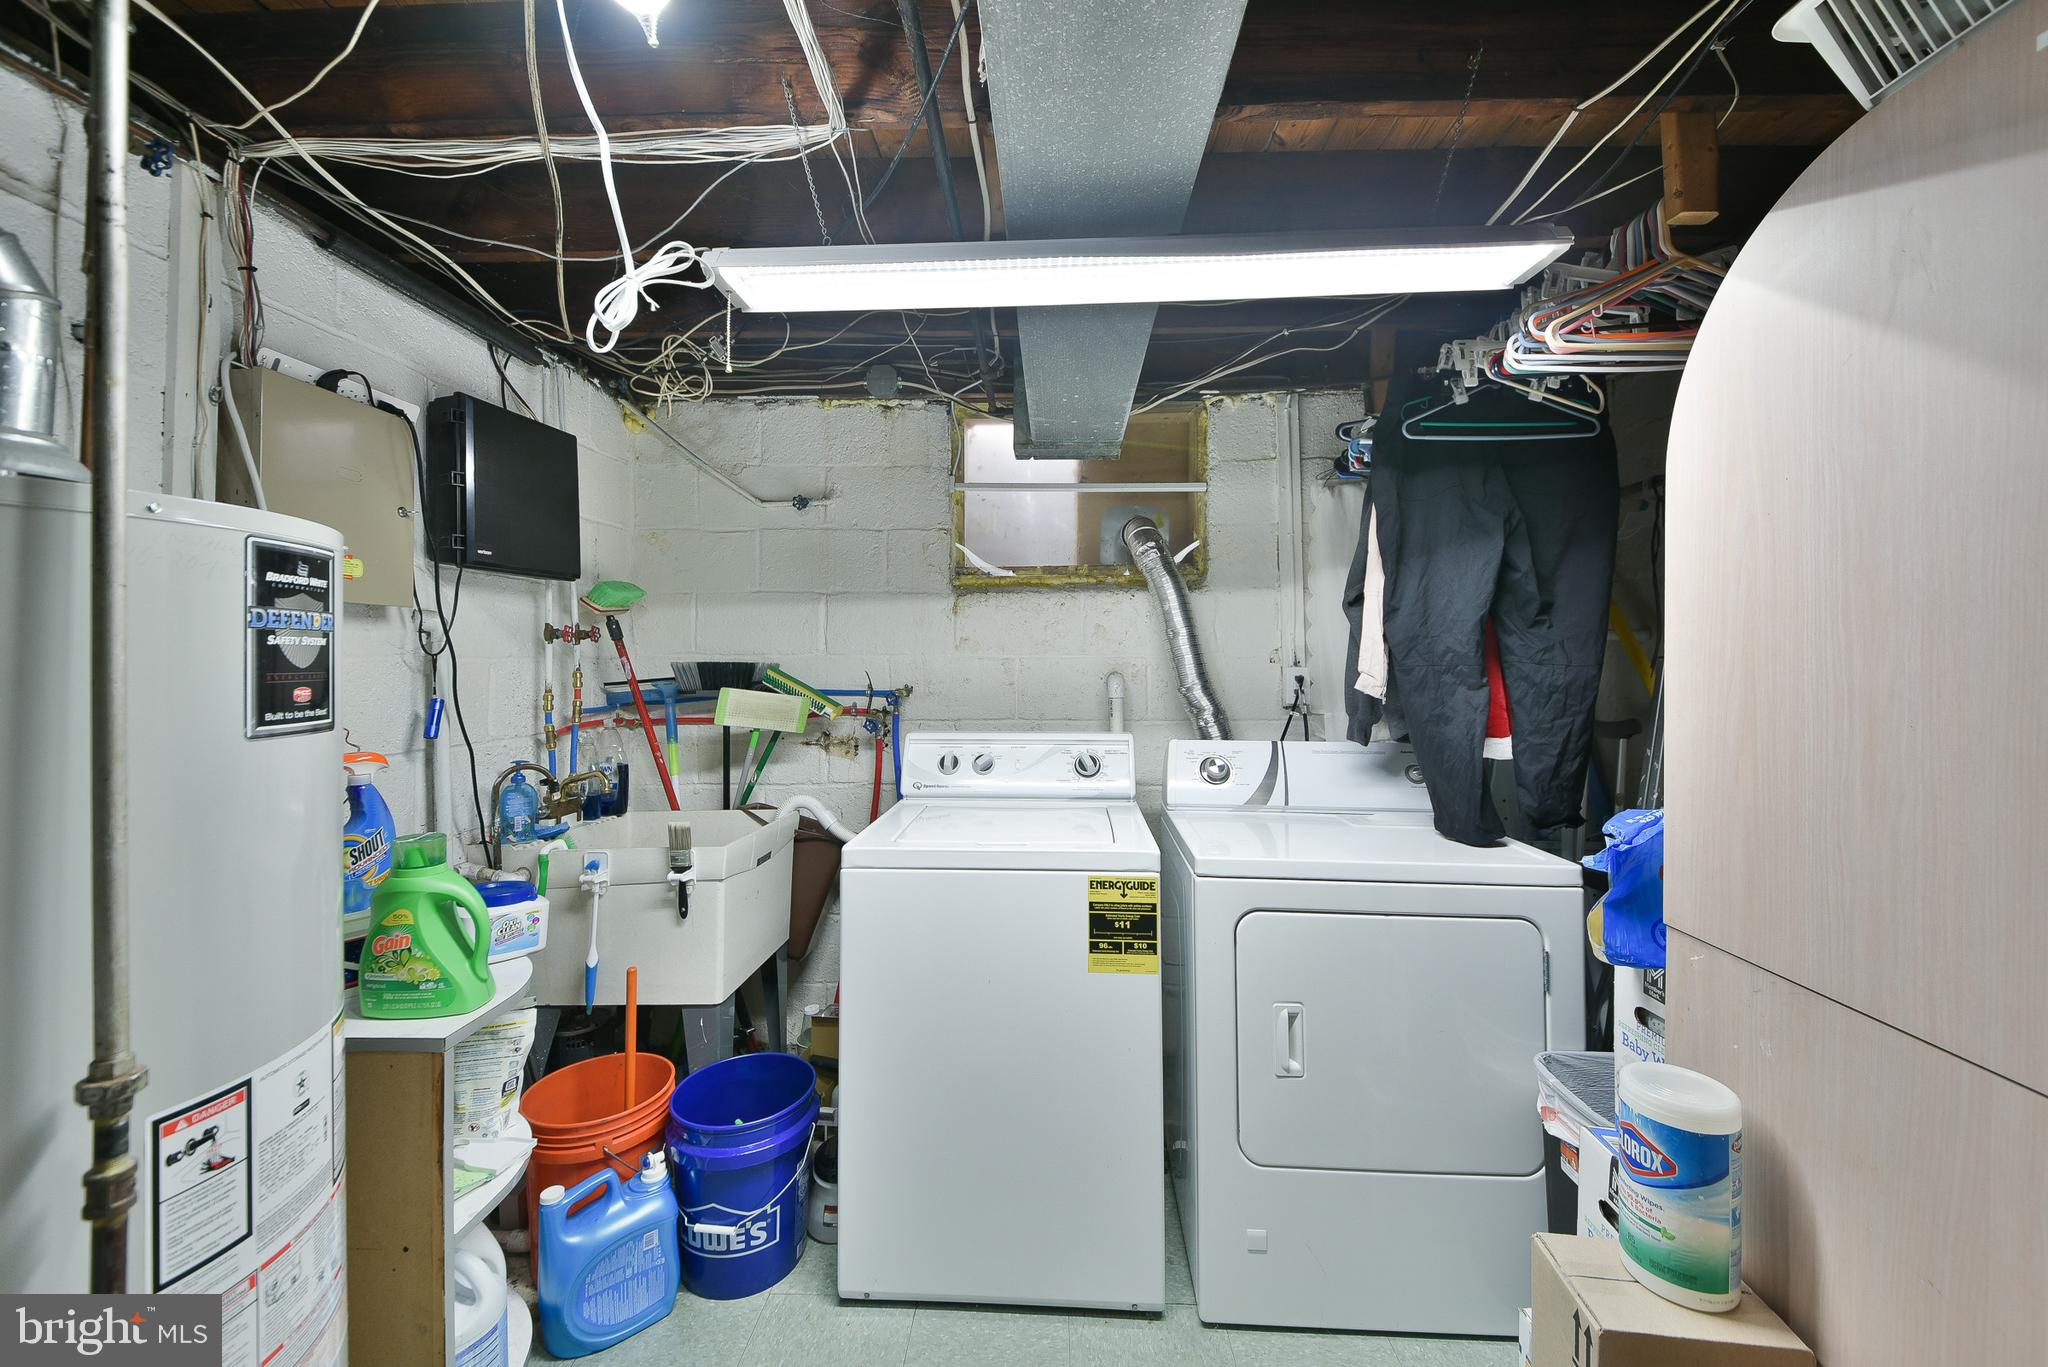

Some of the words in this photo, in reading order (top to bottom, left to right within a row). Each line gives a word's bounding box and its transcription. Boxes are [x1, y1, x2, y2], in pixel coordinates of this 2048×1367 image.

[265, 571, 309, 586] BRADFORD
[249, 607, 334, 631] DEFENDER
[266, 634, 301, 646] SAFETY
[301, 635, 327, 646] SYSTEM
[264, 711, 284, 721] Built
[285, 711, 294, 720] to
[294, 709, 304, 719] be
[304, 709, 315, 718] the
[349, 828, 384, 866] SHOUT
[1089, 880, 1156, 892] ENERGYGUIDE
[1114, 920, 1131, 929] $11
[373, 934, 411, 955] Gain
[1644, 981, 1665, 997] Member's
[1622, 1031, 1649, 1062] Baby
[191, 1097, 238, 1127] DANGER
[1620, 1129, 1664, 1175] LOROX
[683, 1221, 767, 1251] OWE'S
